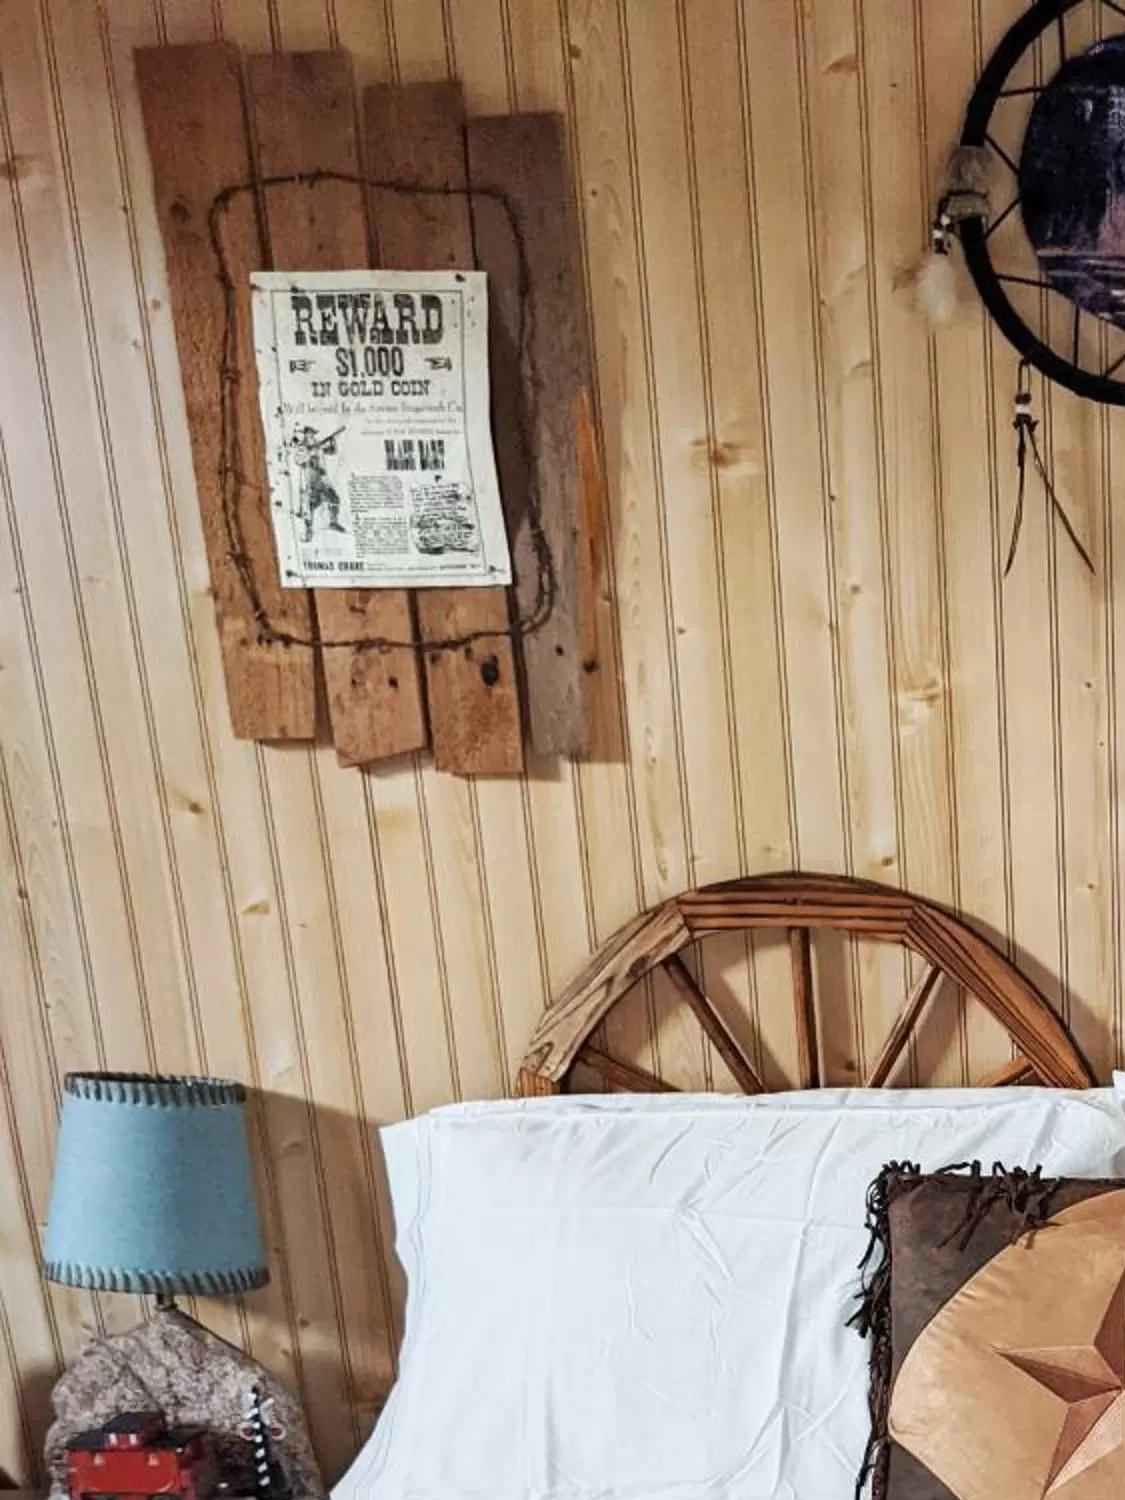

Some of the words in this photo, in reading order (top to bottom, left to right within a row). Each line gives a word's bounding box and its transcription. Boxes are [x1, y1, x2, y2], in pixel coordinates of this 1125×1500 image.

[291, 293, 444, 346] REWARD
[311, 381, 331, 397] IN
[338, 380, 384, 397] GOLD
[391, 379, 431, 396] COIN
